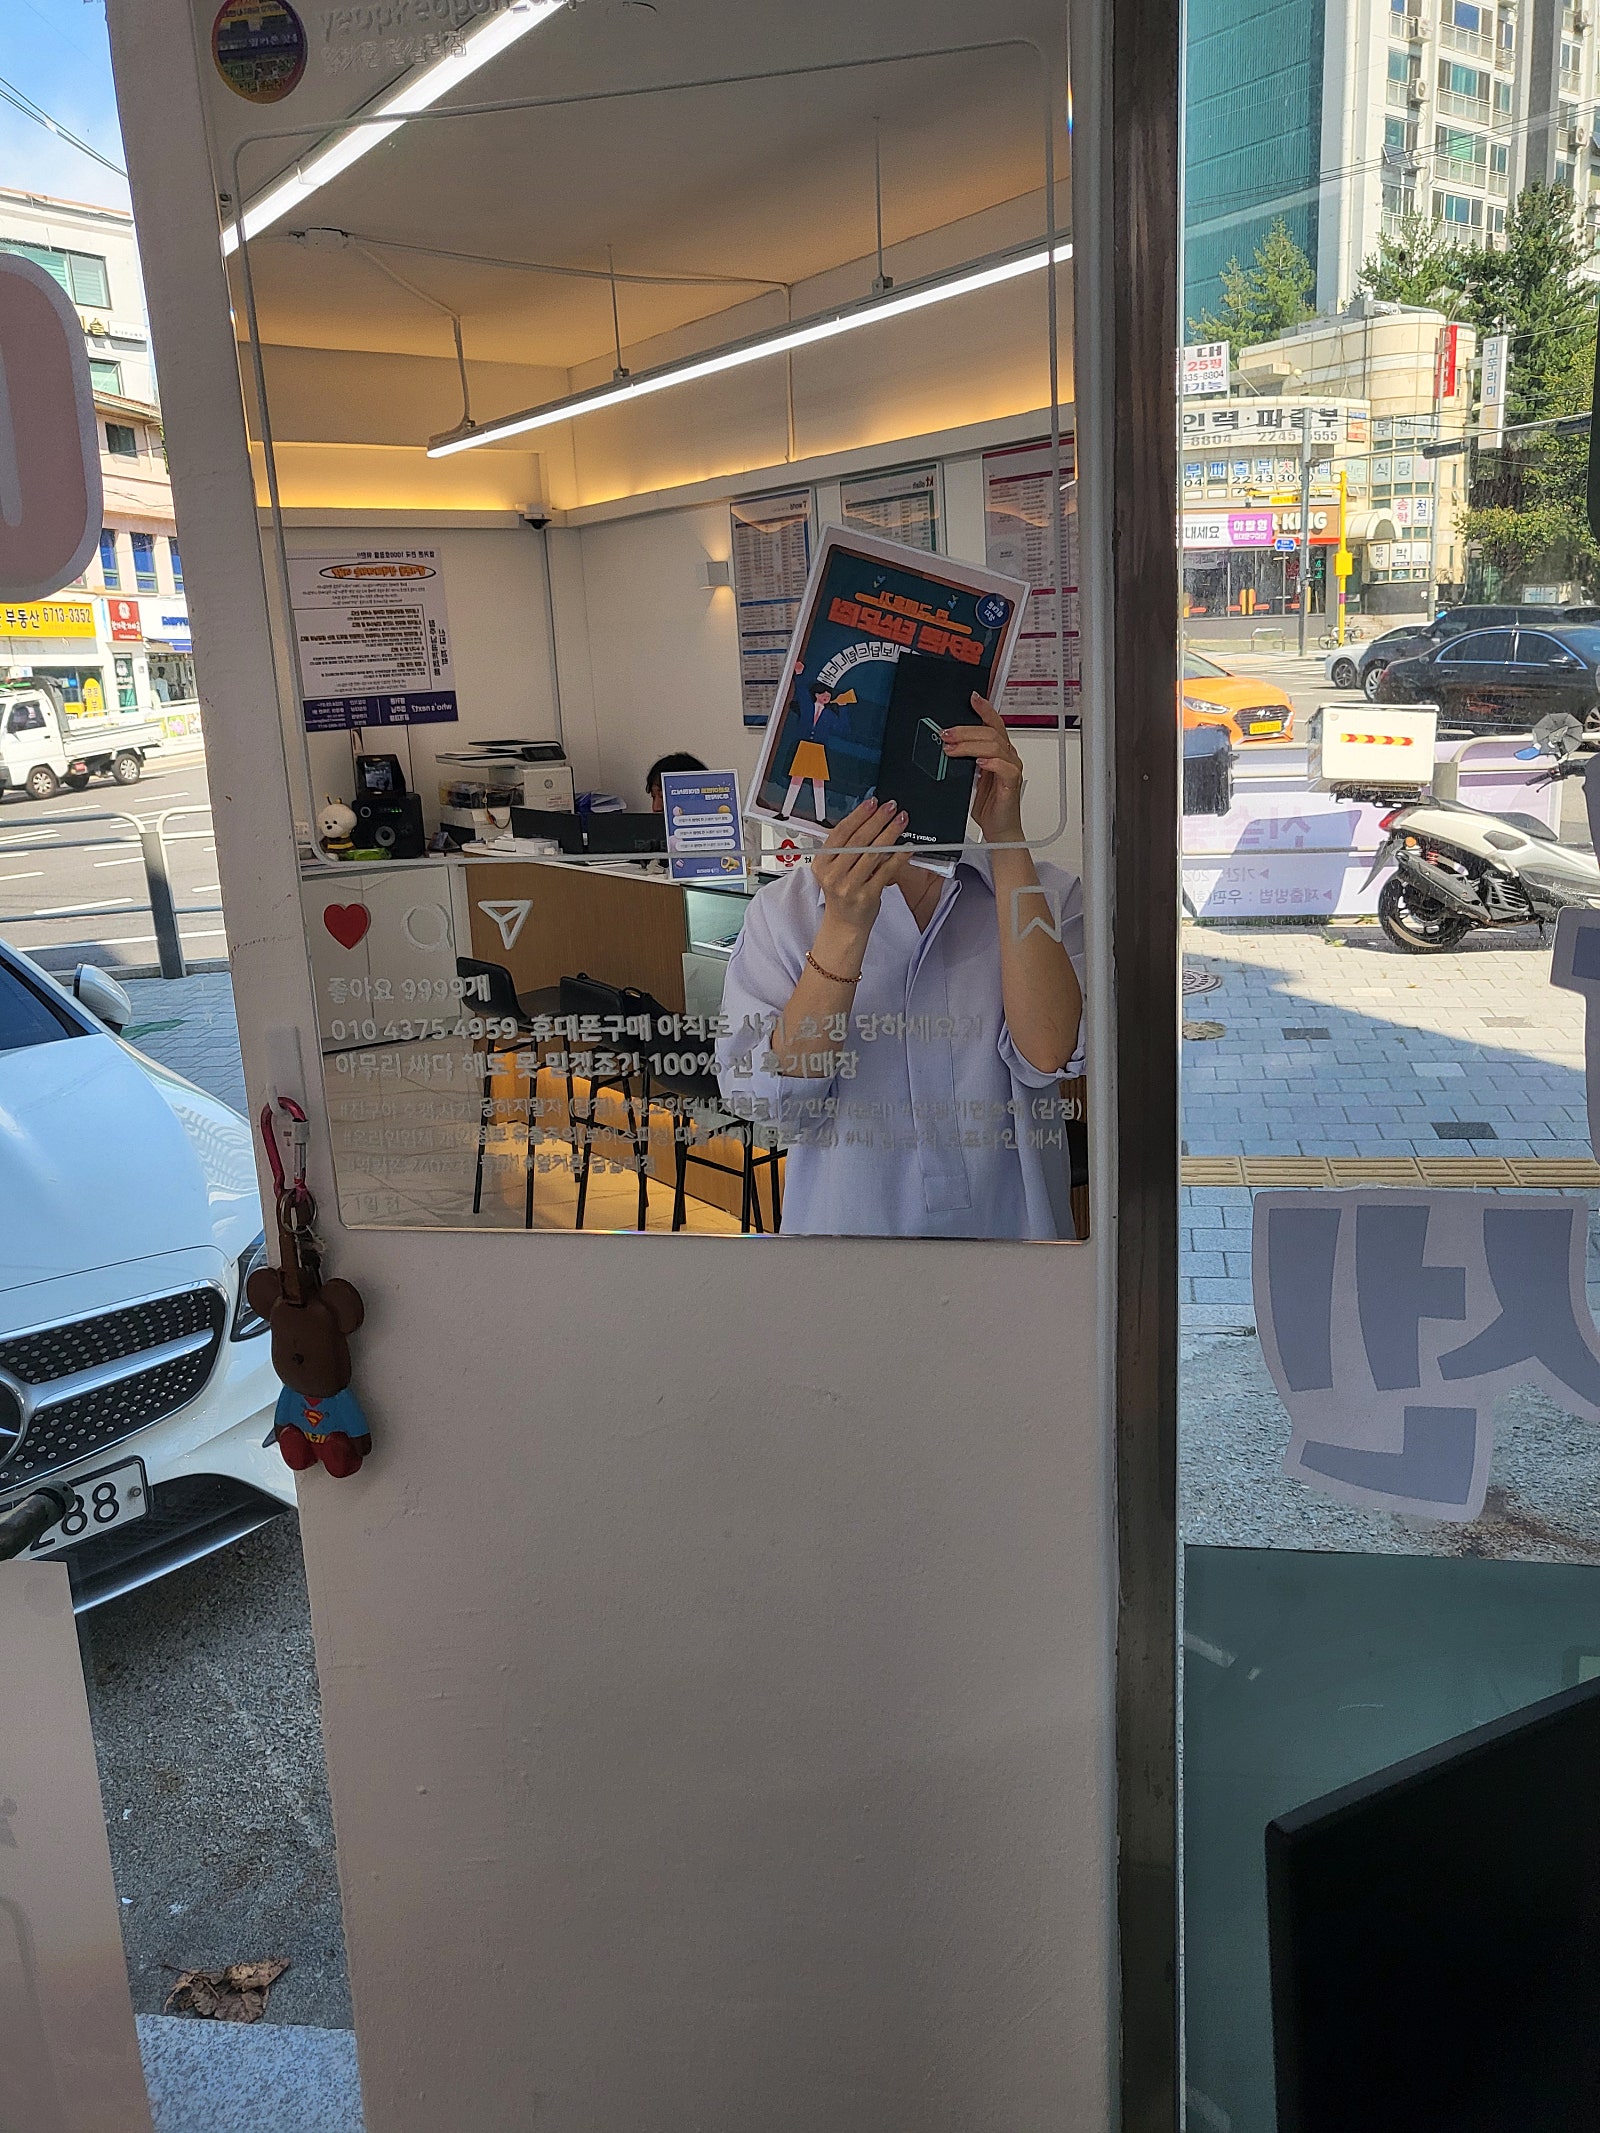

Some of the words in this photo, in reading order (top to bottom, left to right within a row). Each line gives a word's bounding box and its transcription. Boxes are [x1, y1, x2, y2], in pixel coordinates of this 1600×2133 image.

[1487, 343, 1498, 398] 귀뚜라미
[1183, 408, 1239, 433] 인력
[1258, 430, 1338, 443] 2245-555
[5, 609, 40, 629] 부동산
[43, 607, 91, 623] 6713-3352
[327, 976, 395, 1004] 좋아요
[400, 973, 493, 1004] 9999개
[331, 1018, 377, 1041] 010
[384, 1018, 446, 1040] 4375
[657, 1013, 733, 1043] 아직도
[334, 1053, 402, 1080] 아무리
[407, 1053, 454, 1082] 싸다
[461, 1052, 508, 1078] 해도
[516, 1052, 540, 1077] 못
[545, 1052, 639, 1078] 믿겠죠?!
[648, 1052, 721, 1077] 100%
[480, 1097, 563, 1118] 당하지말자
[1031, 1096, 1083, 1121] (감정)
